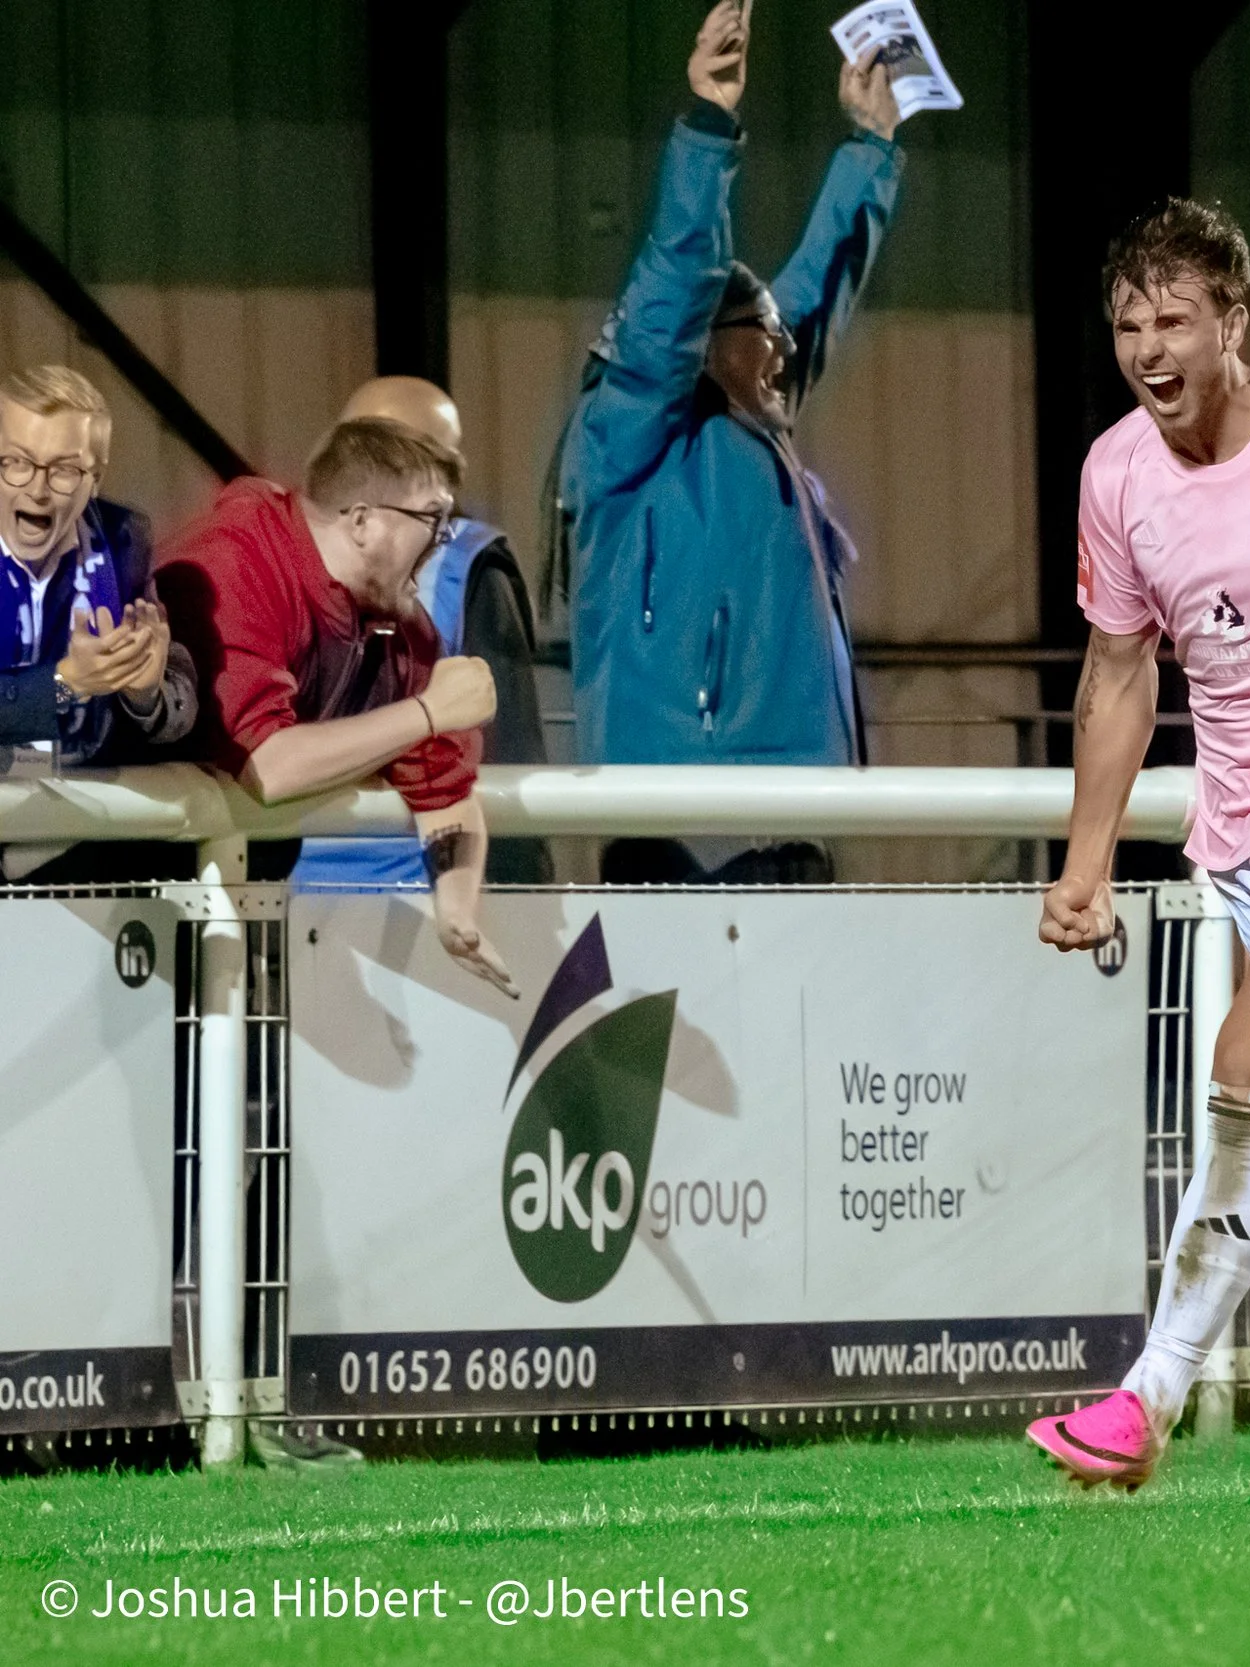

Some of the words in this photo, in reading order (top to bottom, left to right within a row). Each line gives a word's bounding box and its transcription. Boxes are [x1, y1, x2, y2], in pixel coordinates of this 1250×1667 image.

[840, 1062, 886, 1104] We
[894, 1072, 967, 1116] grow
[841, 1118, 929, 1162] better
[510, 1128, 634, 1252] akp
[650, 1179, 767, 1239] group
[840, 1175, 966, 1232] together
[339, 1349, 452, 1394] 01652
[465, 1345, 597, 1391] 686900
[831, 1326, 1088, 1385] www.arkpro.co.uk
